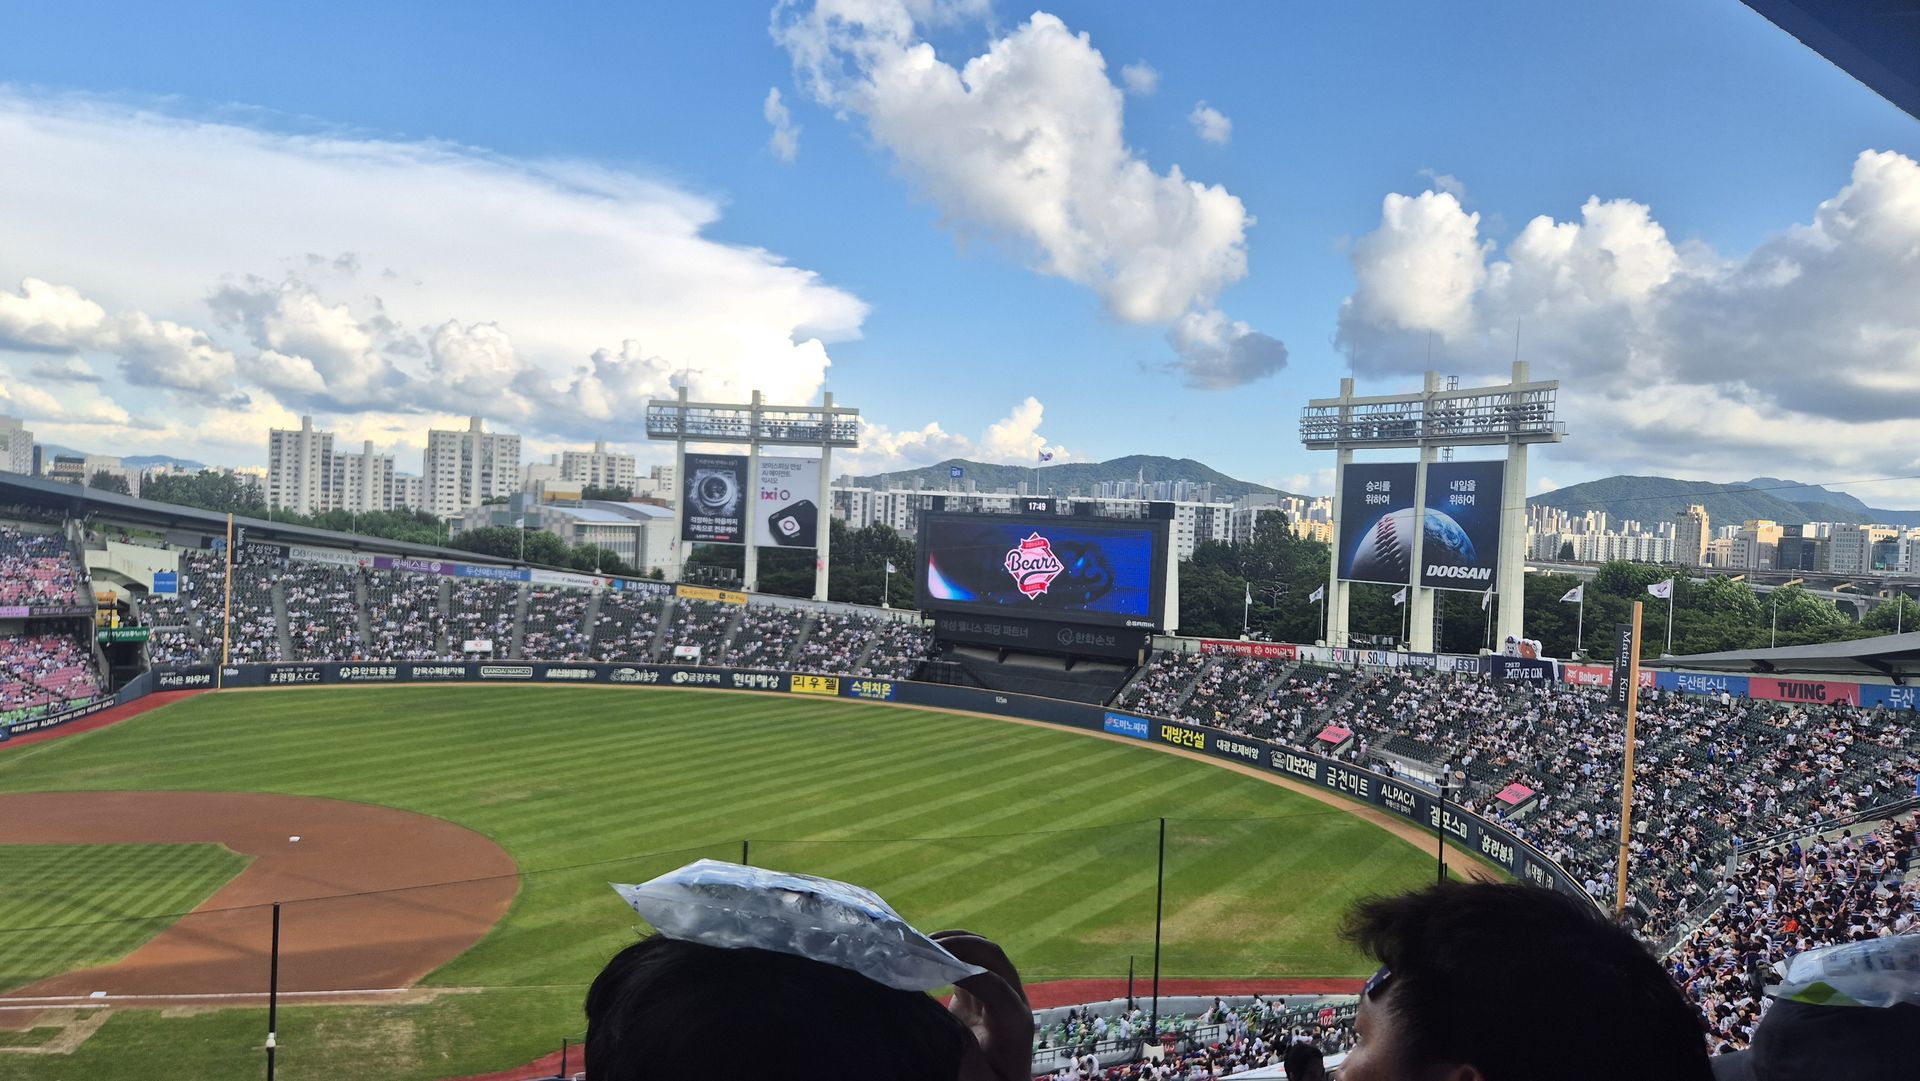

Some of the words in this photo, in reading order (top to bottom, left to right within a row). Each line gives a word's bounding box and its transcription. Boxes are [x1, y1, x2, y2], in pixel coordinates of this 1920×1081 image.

[1365, 480, 1391, 492] 승리를
[1450, 480, 1476, 492] 내일을
[1028, 501, 1046, 511] 17:49
[1365, 494, 1390, 505] 위하여
[1449, 494, 1475, 506] 위하여
[1008, 550, 1060, 585] Bears
[1426, 565, 1491, 580] DOOSAN
[940, 619, 958, 631] 여성
[984, 623, 1002, 636] 리딩
[1002, 625, 1029, 638] 파트너
[1075, 632, 1115, 646] 한화손보
[1621, 630, 1632, 667] Matin
[351, 666, 397, 676] 유안타증권
[688, 672, 721, 683] 금강주택
[1530, 667, 1543, 679] ON
[1578, 671, 1603, 684] Bobcat
[732, 672, 780, 689] 현대해상
[851, 680, 892, 696] 스위치온
[1677, 675, 1727, 692] 두산테스나
[1778, 682, 1826, 701] TVING
[1889, 687, 1917, 710] 두산
[1112, 718, 1148, 735] 도미노피자
[1161, 724, 1205, 750] 대방건설
[1286, 754, 1317, 780] 대보건설
[1326, 765, 1369, 797] 금천미트
[1380, 783, 1416, 808] ALPACA
